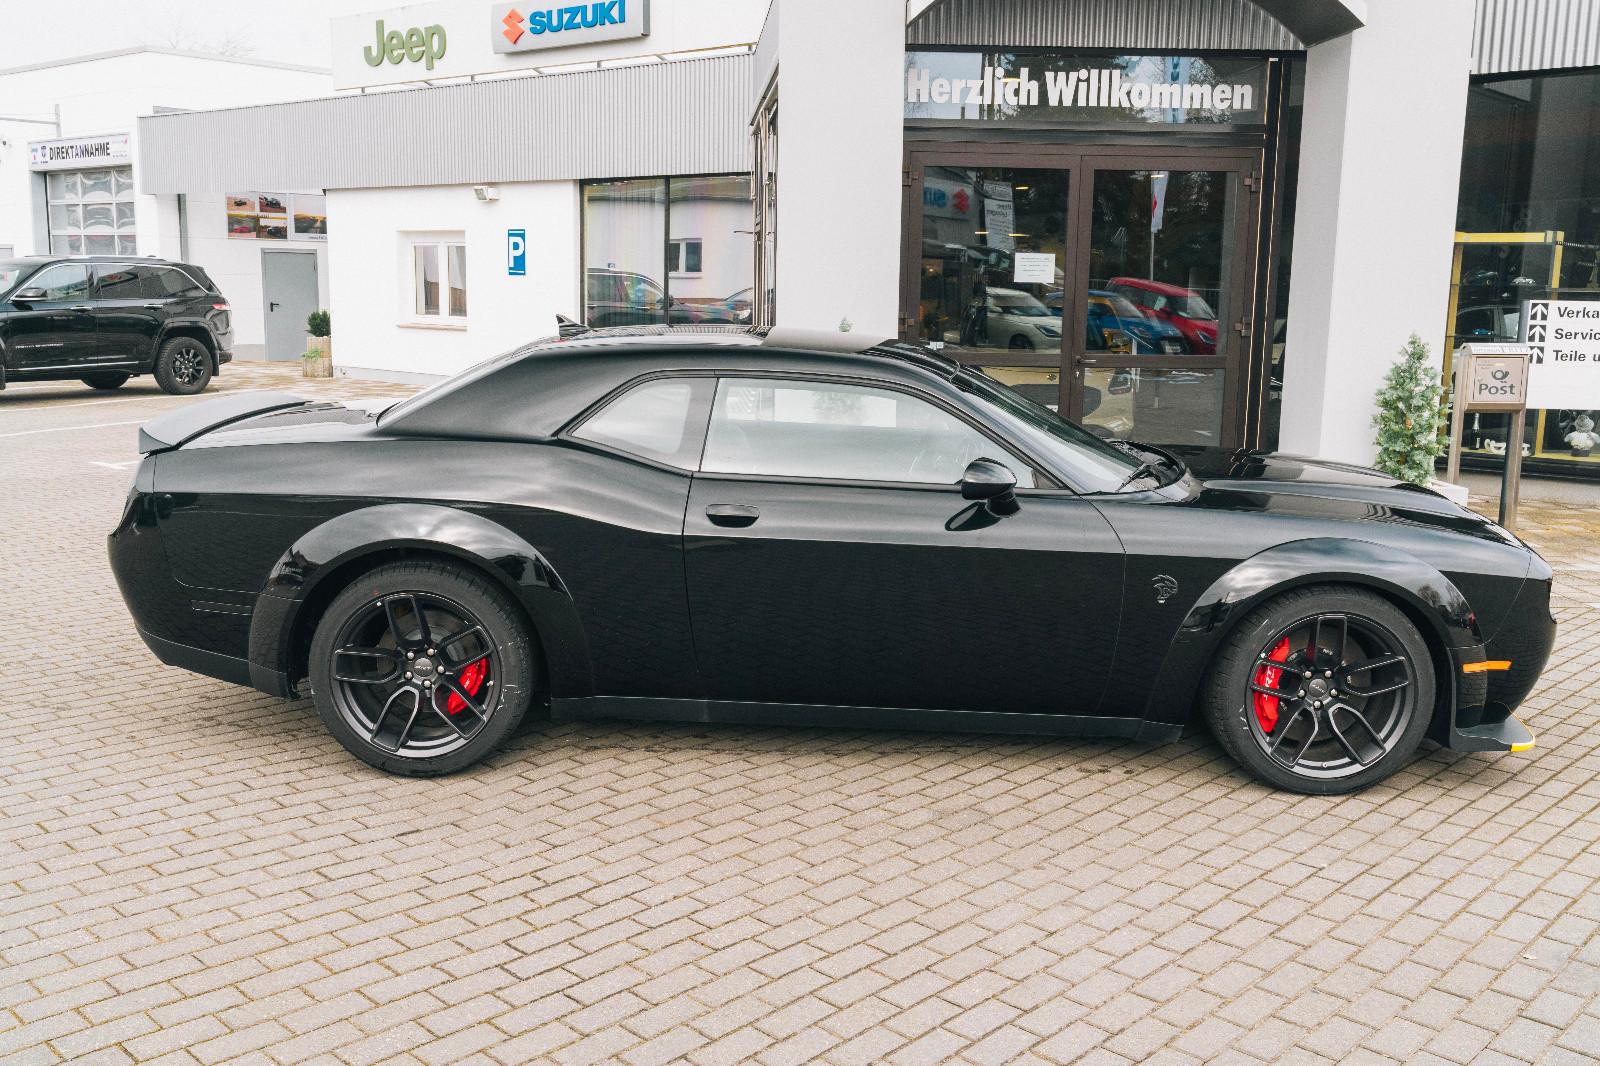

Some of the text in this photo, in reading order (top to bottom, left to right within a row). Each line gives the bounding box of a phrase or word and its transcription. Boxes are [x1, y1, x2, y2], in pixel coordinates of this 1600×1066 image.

[529, 0, 626, 35] SUZUKI
[364, 19, 447, 70] Jeep
[907, 66, 1253, 110] Herzlich Willkommen
[49, 142, 110, 160] DIREKTANNAHME
[508, 236, 525, 268] P
[1557, 306, 1600, 319] Verka
[1554, 328, 1600, 341] Servic
[1552, 349, 1586, 362] Teile
[1478, 383, 1516, 395] Post
